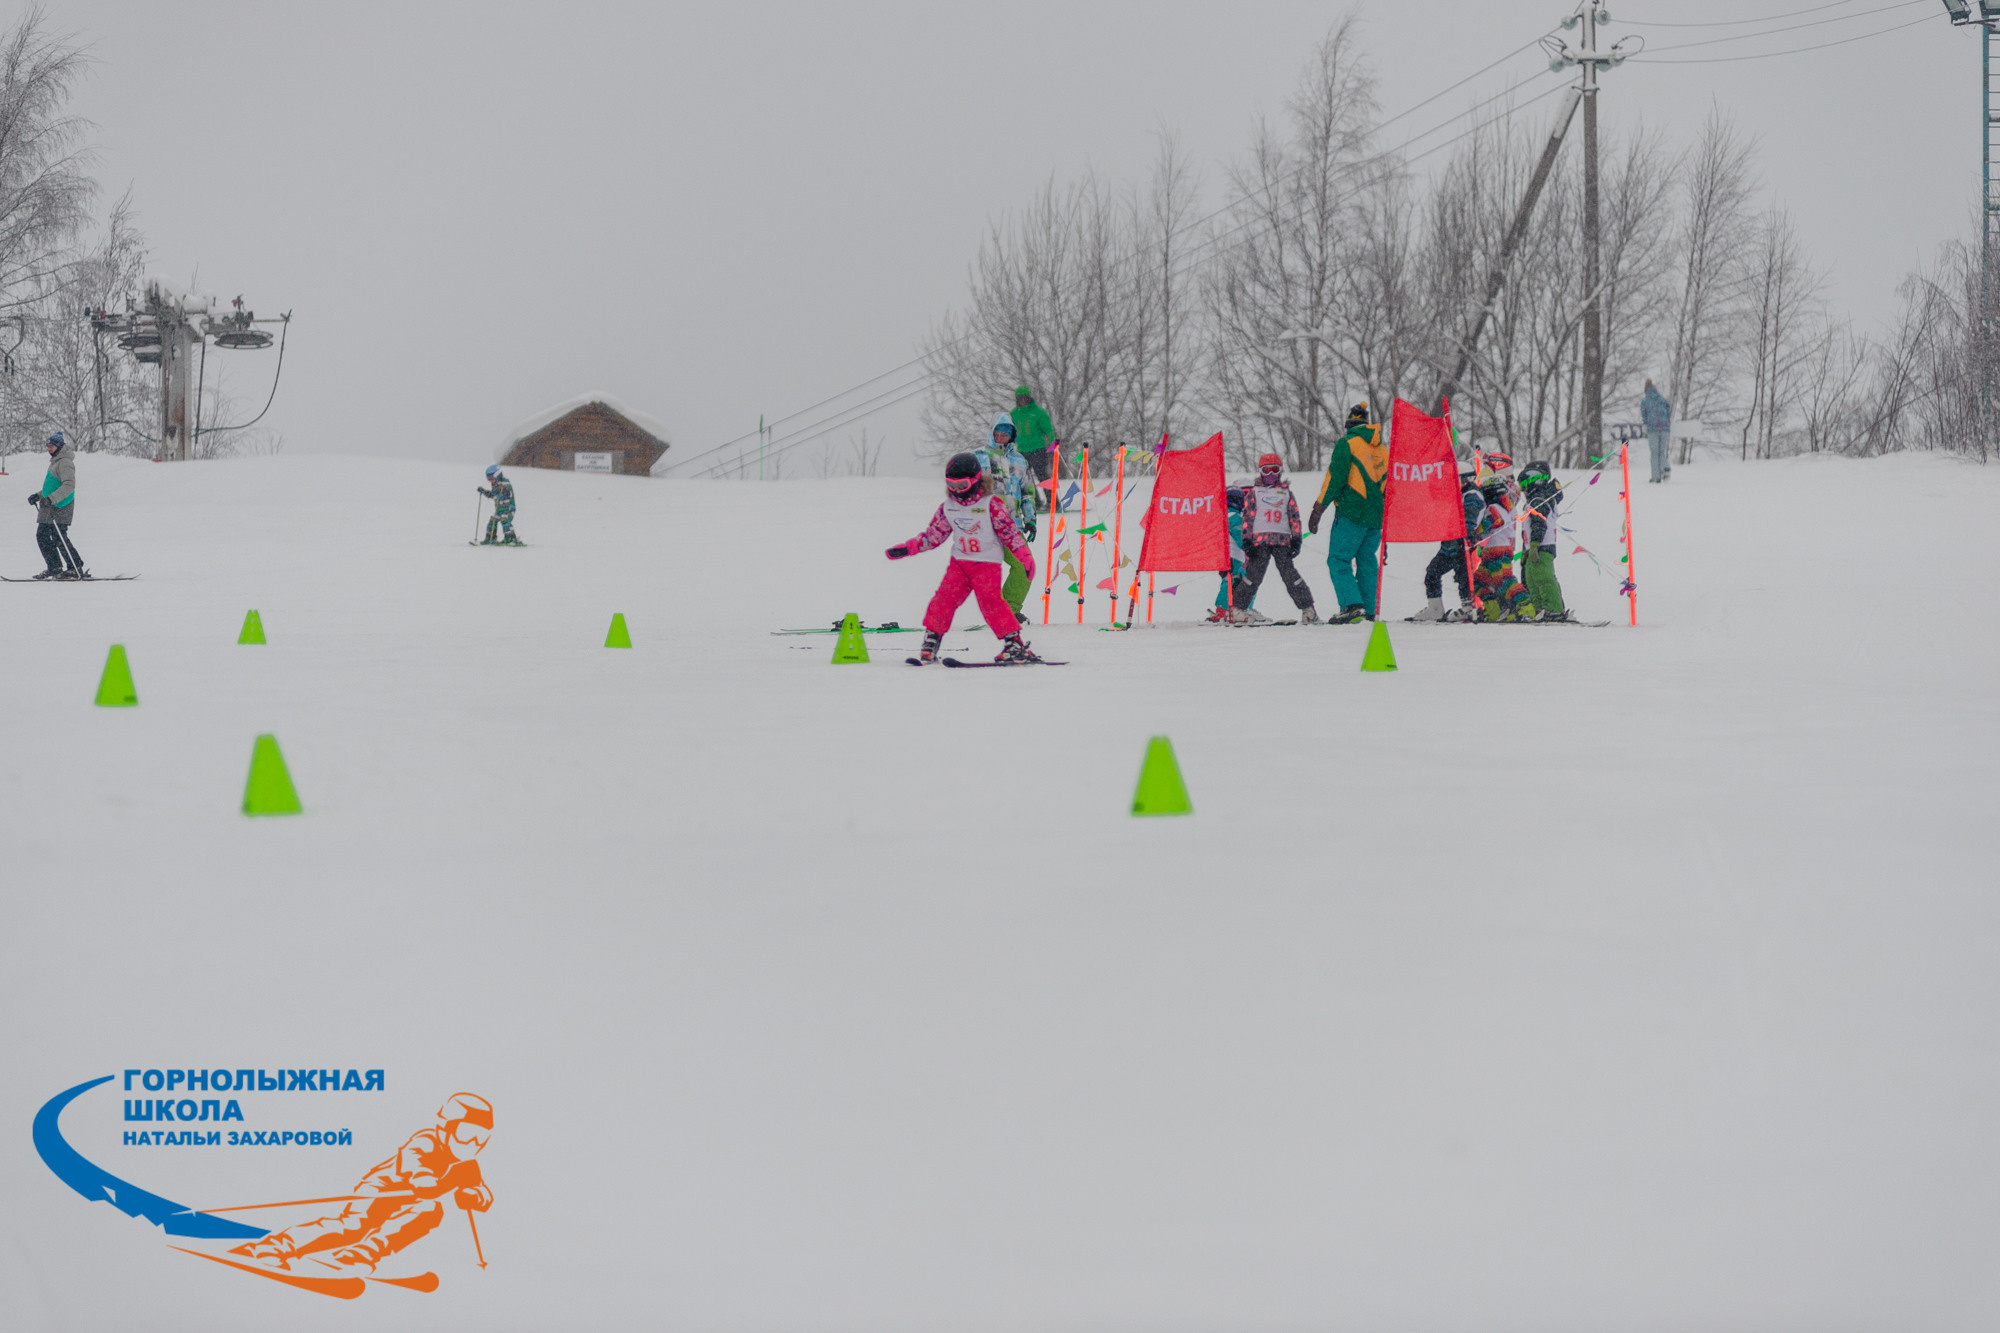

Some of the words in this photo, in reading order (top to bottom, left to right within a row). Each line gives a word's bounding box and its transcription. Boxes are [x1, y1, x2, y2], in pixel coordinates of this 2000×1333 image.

[1393, 461, 1445, 482] СТАРТ
[1159, 494, 1215, 515] СТАРТ
[1264, 509, 1282, 523] 19
[959, 537, 981, 553] 18
